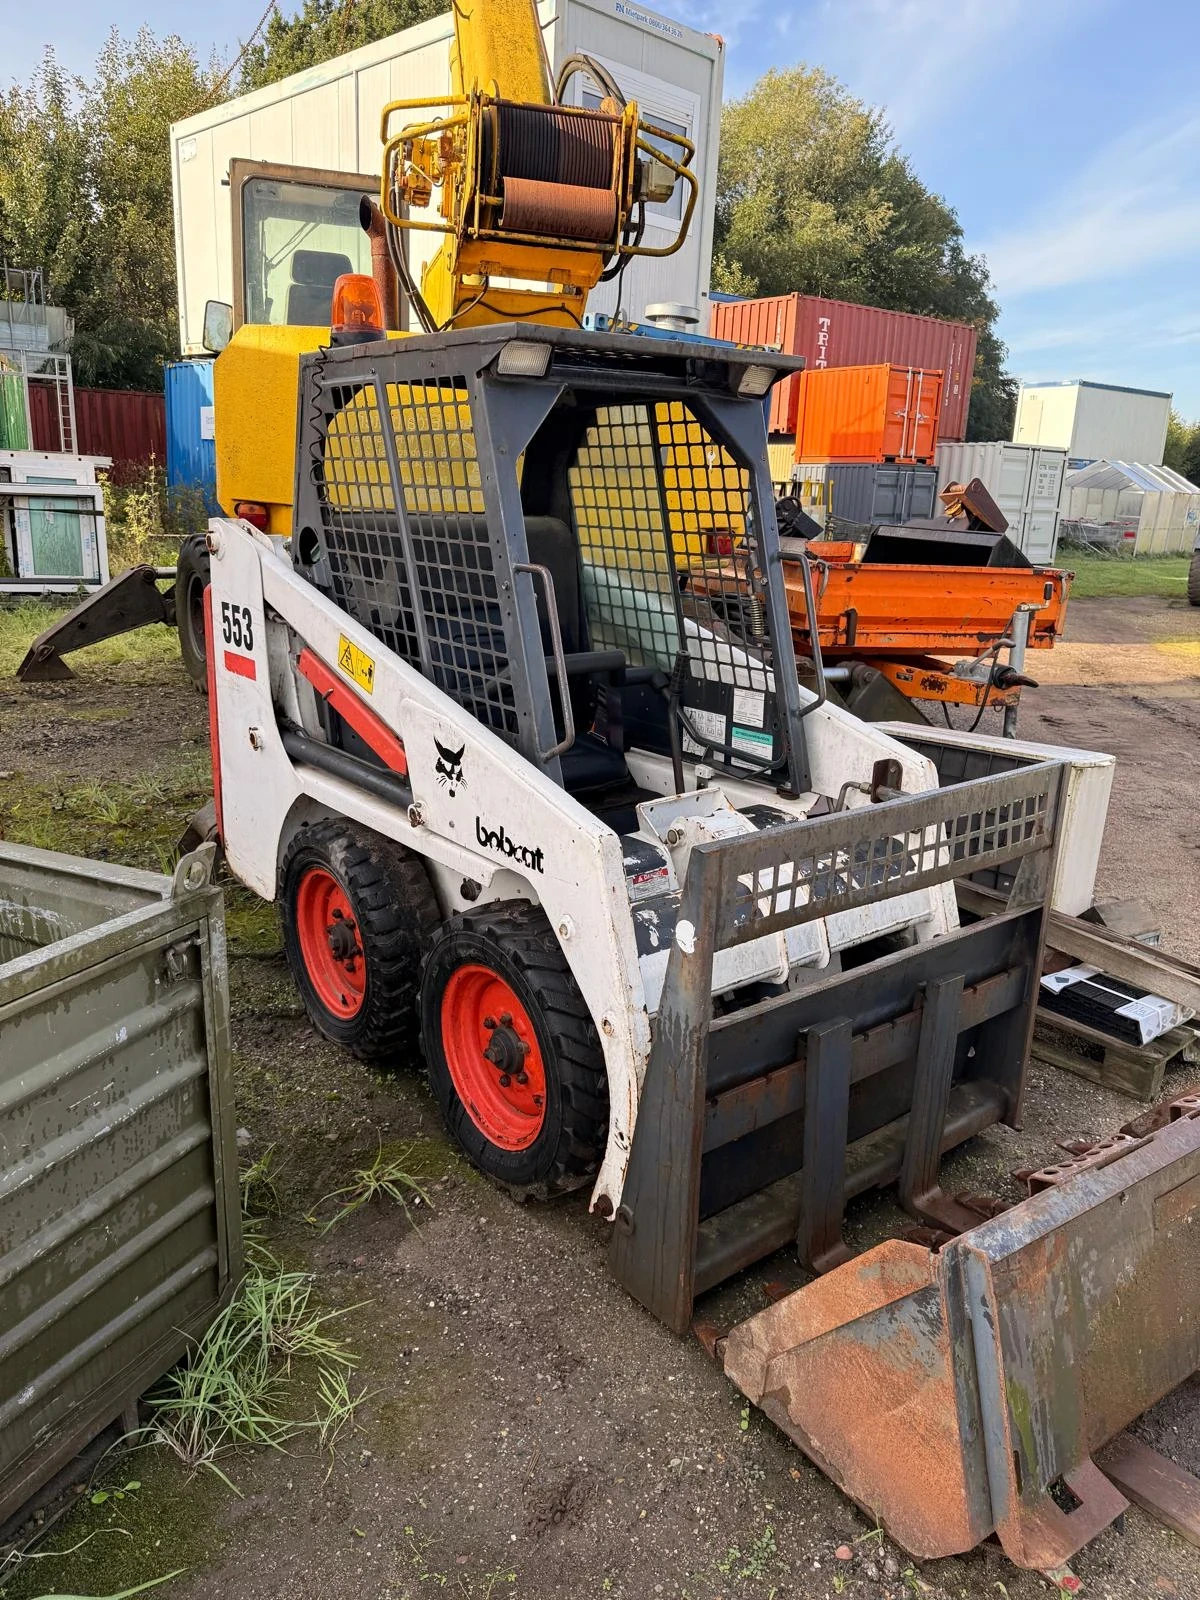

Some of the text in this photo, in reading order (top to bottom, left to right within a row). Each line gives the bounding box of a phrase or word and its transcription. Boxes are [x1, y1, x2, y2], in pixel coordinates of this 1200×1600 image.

[625, 8, 648, 23] Mietpark
[221, 601, 254, 651] 553
[475, 815, 544, 875] bobcat
